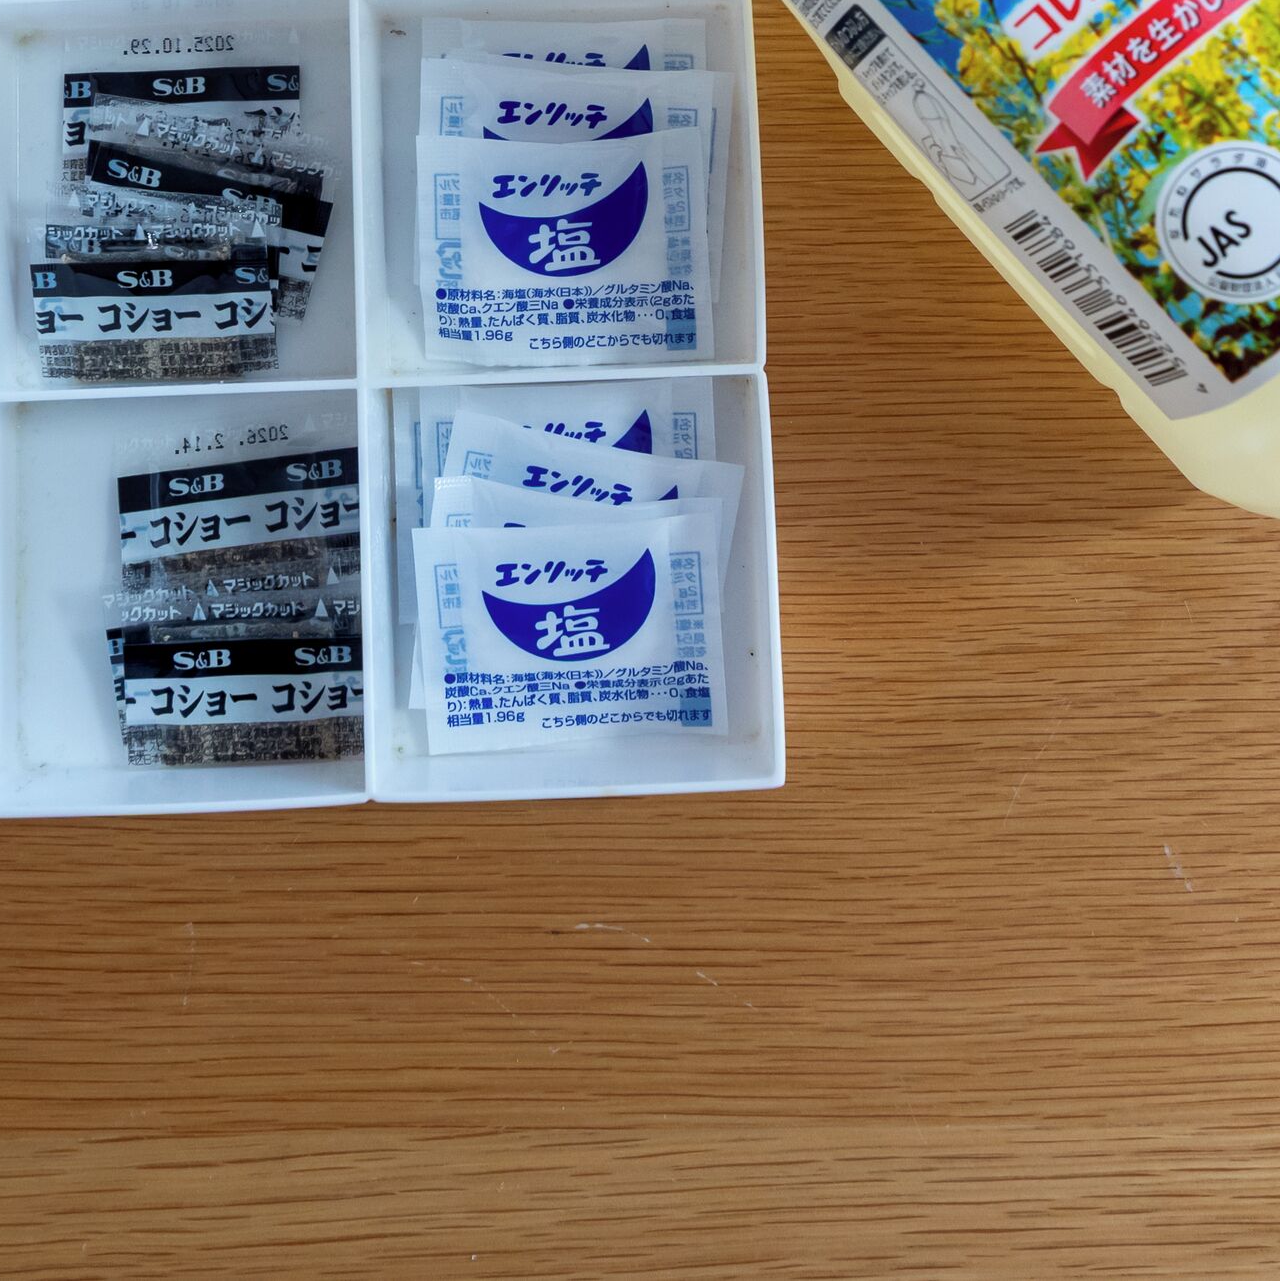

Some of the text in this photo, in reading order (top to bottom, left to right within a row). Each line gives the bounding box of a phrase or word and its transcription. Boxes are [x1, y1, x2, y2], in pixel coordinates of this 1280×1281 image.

[152, 76, 206, 97] S&B
[497, 100, 608, 130] エンリッチ
[107, 159, 162, 189] S&B
[491, 172, 603, 199] エンリッチ
[527, 218, 602, 272] 塩
[1195, 209, 1252, 268] JAS
[116, 268, 173, 289] S&B
[97, 301, 202, 334] コショー
[214, 297, 275, 330] コシ
[168, 458, 343, 498] S&B S&B
[522, 464, 633, 506] エンリッチ
[150, 511, 252, 549] コショー
[495, 558, 609, 588] エンリッチ
[535, 604, 611, 658] 塩
[173, 645, 352, 671] S&B S&B
[150, 684, 258, 719] コショー
